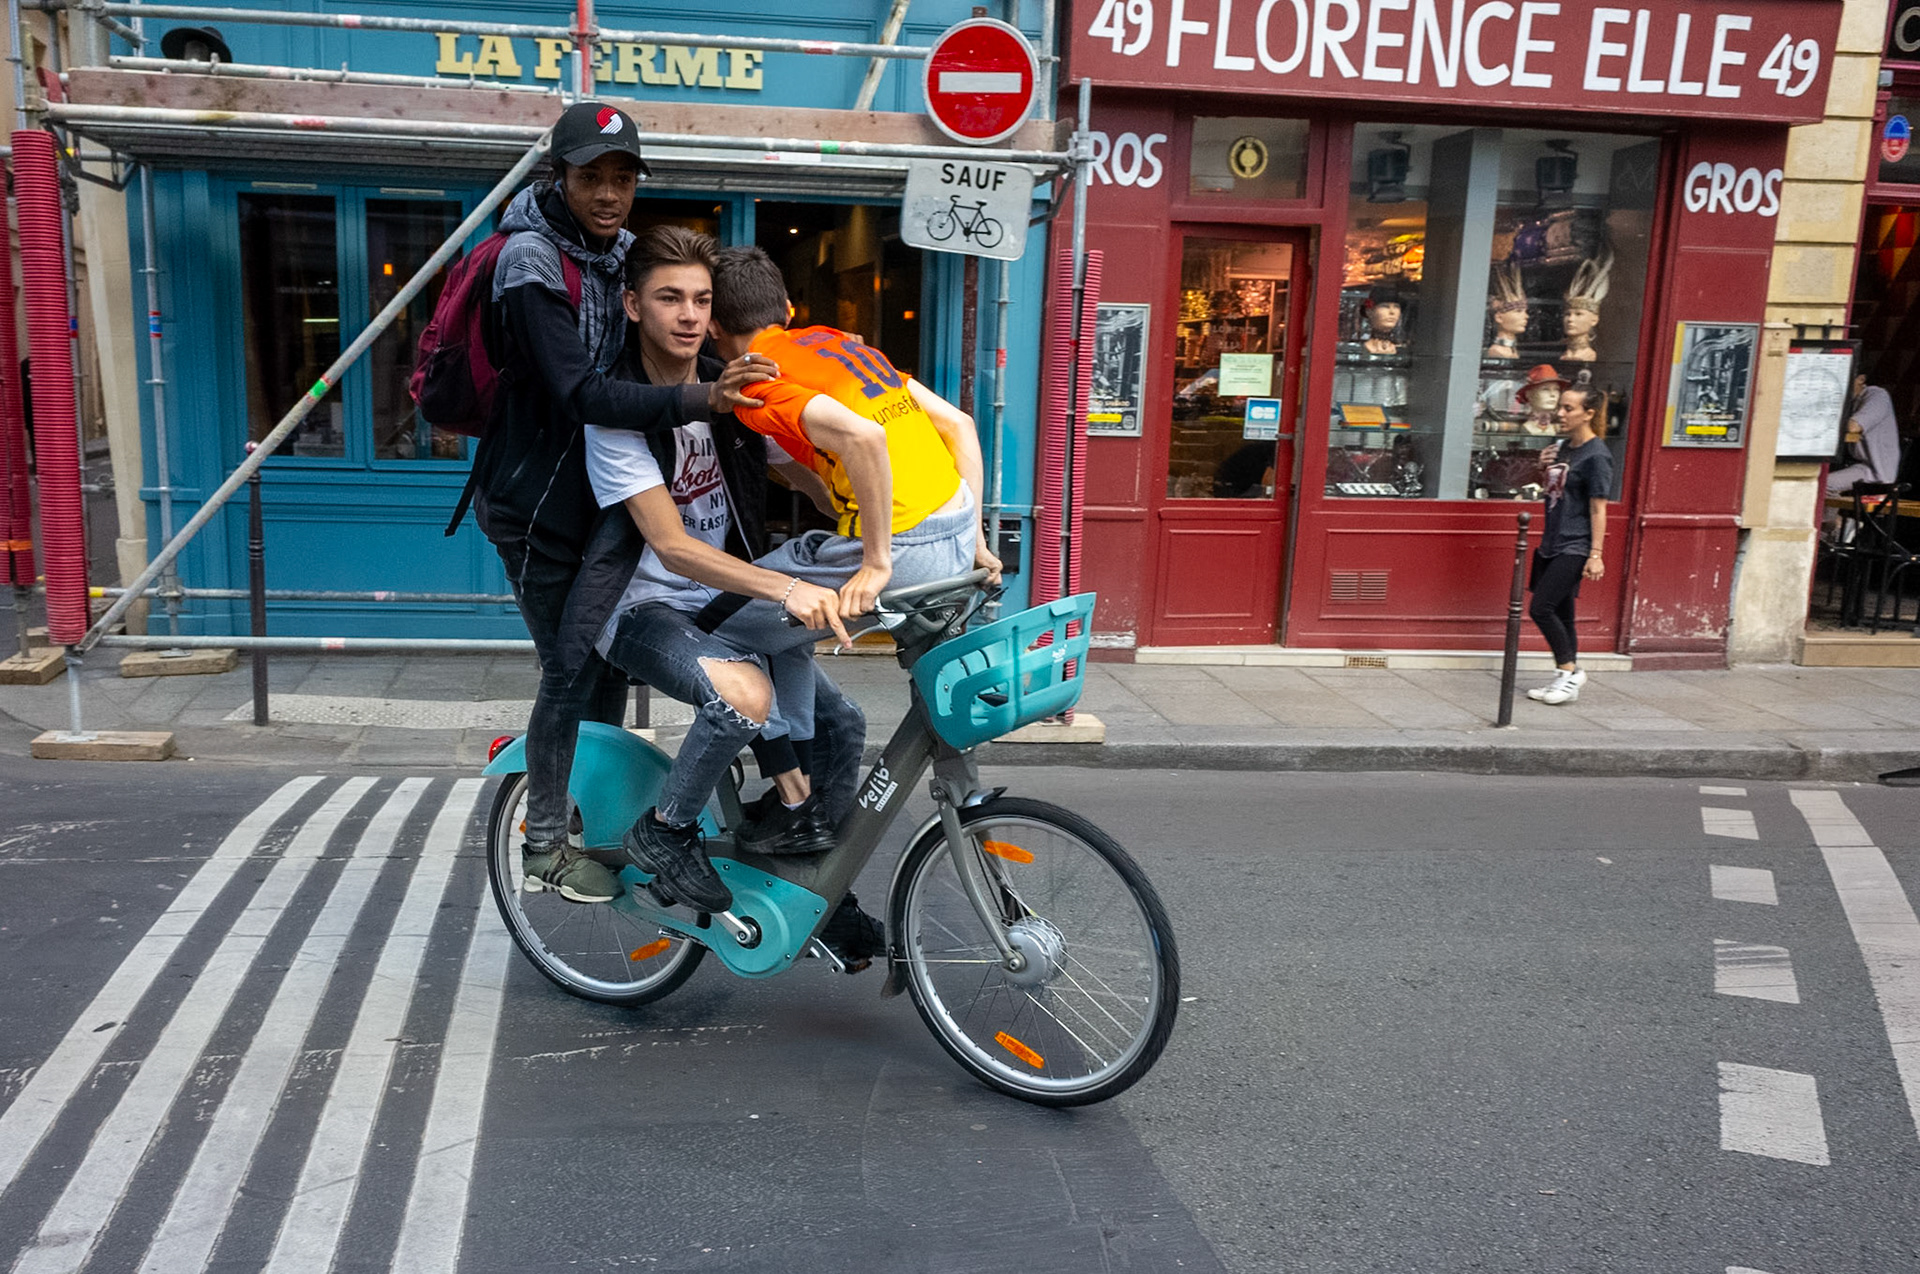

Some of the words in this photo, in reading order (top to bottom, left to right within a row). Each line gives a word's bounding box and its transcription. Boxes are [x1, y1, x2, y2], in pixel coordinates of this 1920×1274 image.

[435, 32, 522, 77] LA
[1088, 0, 1153, 56] 49
[1166, 0, 1561, 88] FLORENCE
[1583, 7, 1752, 98] ELLE
[1758, 33, 1820, 97] 49
[941, 163, 1006, 191] SAUF
[1062, 131, 1167, 188] ROS
[1684, 161, 1783, 217] GROS
[816, 340, 903, 399] 10
[872, 395, 914, 426] unicef
[680, 513, 695, 528] ER
